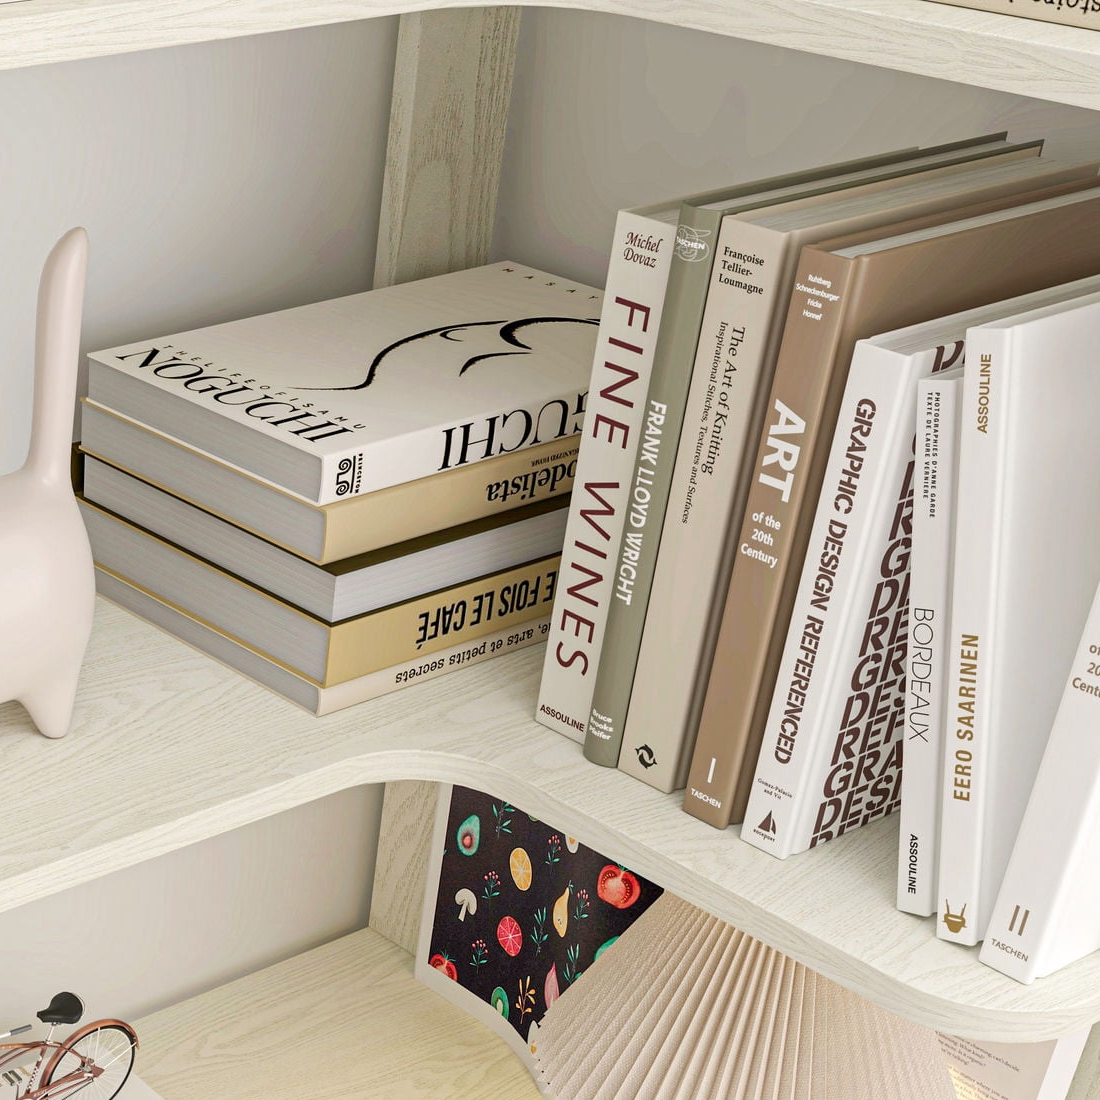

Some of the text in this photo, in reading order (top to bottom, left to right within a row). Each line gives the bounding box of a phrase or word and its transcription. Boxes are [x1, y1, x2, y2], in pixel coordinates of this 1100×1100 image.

[625, 231, 663, 253] Michel
[723, 246, 765, 267] Françoise
[623, 247, 657, 269] Dovaz
[721, 260, 753, 276] Tellier-
[718, 273, 764, 296] Loumagne
[116, 346, 359, 444] NOGUCHI
[700, 326, 746, 476] The Art of Knitting
[976, 353, 992, 434] ASSOULINE
[681, 320, 729, 525] Inspirational Stitches, Textures and Surfaces
[931, 392, 940, 457] PHOTOGRAPHIES
[758, 399, 807, 503] ART
[555, 296, 651, 677] FINE WINES
[615, 400, 667, 606] FRANK LLOYD WRIGHT
[929, 492, 937, 518] GARDE
[752, 510, 781, 531] of the
[751, 528, 775, 547] 20th
[740, 542, 779, 570] Century
[498, 576, 541, 616] FOIS
[774, 398, 877, 765] GRAPHIC DESIGN REFERENCED
[469, 591, 495, 627] LE
[415, 600, 467, 650] CAFÉ
[506, 628, 534, 647] arts
[449, 641, 487, 666] petits
[490, 638, 504, 654] et
[395, 657, 445, 684] secrets
[908, 607, 934, 743] BORDEAUX
[539, 704, 585, 733] ASSOULINE
[953, 633, 979, 802] EERO SAARINEN
[690, 787, 722, 810] TASCHEN
[907, 833, 918, 895] ASSOULINE
[990, 937, 1029, 963] TASCHEN
